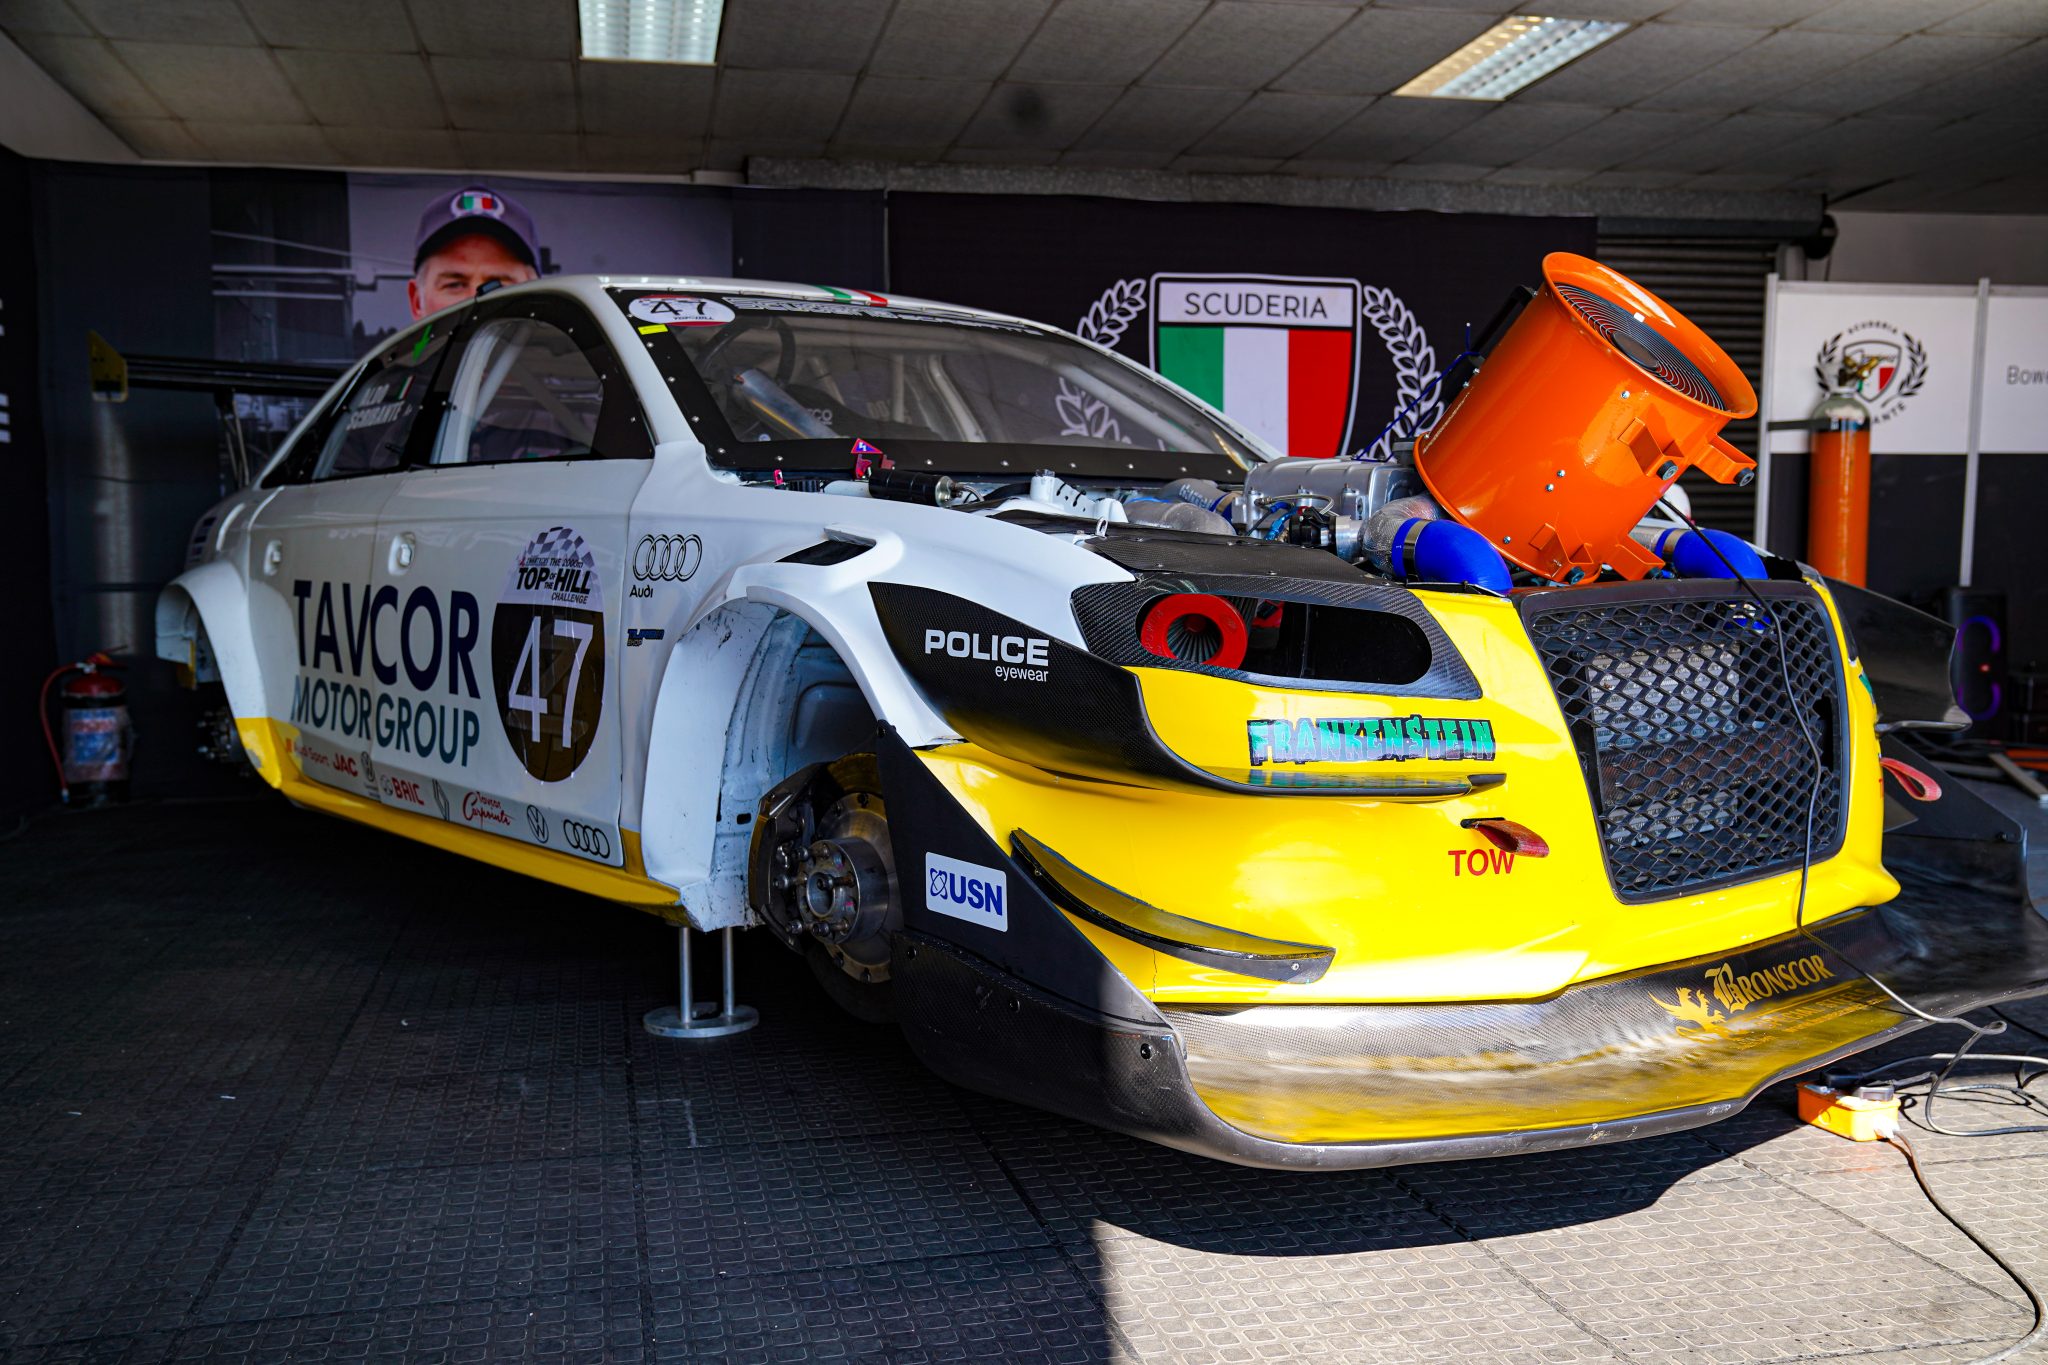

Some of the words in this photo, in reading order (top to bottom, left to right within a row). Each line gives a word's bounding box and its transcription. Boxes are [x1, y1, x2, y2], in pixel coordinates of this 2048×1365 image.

[1184, 292, 1328, 319] SCUDERIA
[517, 566, 550, 590] TOP
[553, 567, 591, 594] HILL
[629, 584, 654, 598] Audi
[551, 592, 589, 604] CHALLENGE
[293, 578, 481, 699] TAVCOR
[925, 628, 1050, 667] POLICE
[508, 615, 594, 748] 47
[995, 664, 1049, 683] eyewear
[1246, 713, 1496, 767] FRANKENSTEIN
[333, 751, 358, 777] JAC
[391, 776, 425, 806] BAIC
[1447, 847, 1515, 877] TOW
[949, 872, 1003, 917] USN
[1704, 954, 1837, 1014] BRONSCOR
